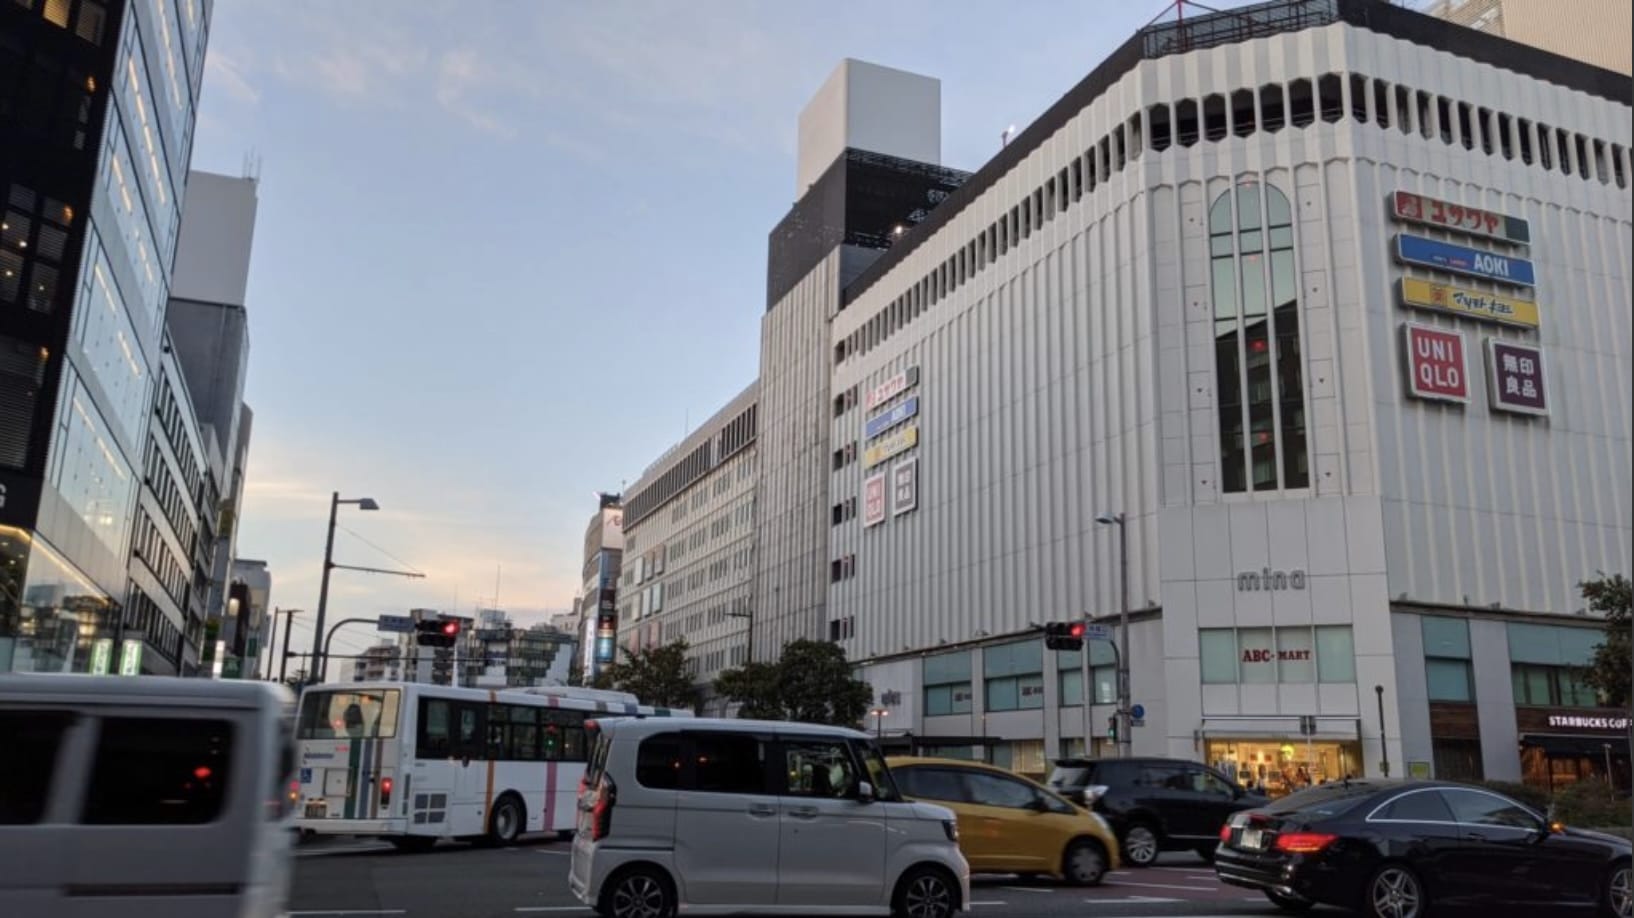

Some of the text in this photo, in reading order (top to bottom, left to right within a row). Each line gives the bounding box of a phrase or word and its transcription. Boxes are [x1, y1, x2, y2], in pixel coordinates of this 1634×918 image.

[1474, 253, 1509, 276] AOKI
[1417, 337, 1454, 362] UNI
[1420, 363, 1459, 388] QLO
[1237, 566, 1306, 592] mina
[1549, 716, 1632, 729] STARBUCKS COF
